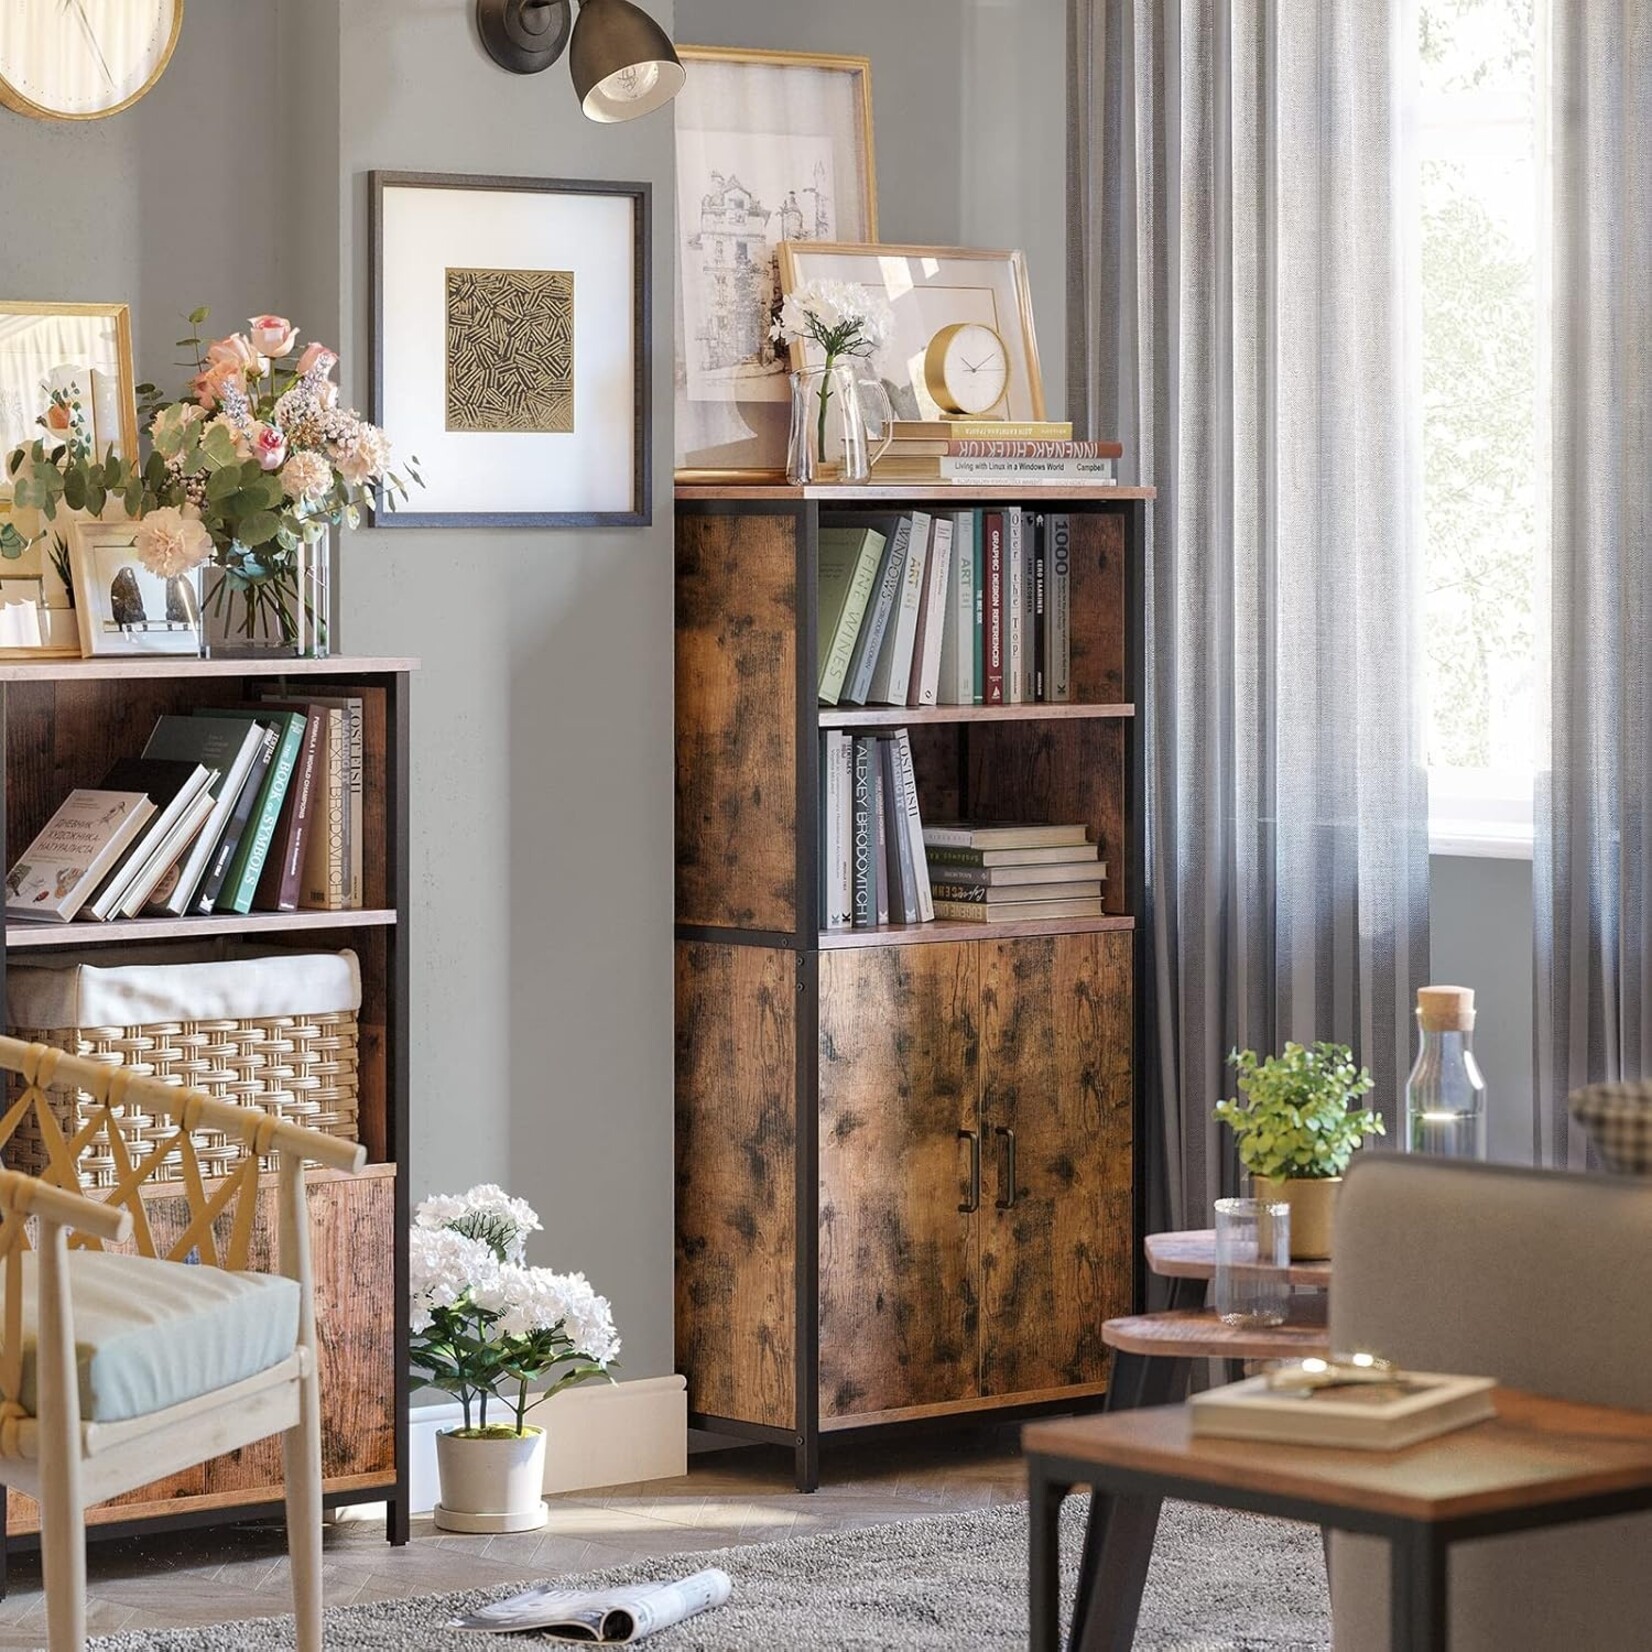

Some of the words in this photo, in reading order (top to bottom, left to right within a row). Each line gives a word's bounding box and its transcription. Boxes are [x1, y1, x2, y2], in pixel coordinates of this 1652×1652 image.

[955, 463, 974, 471] Living
[1046, 463, 1065, 471] World
[959, 441, 1098, 458] INNENARCHITEKTUR
[1076, 463, 1104, 472] Campbell
[881, 525, 912, 601] WINDOWS
[1055, 521, 1069, 576] 1000
[854, 552, 876, 600] FINE
[907, 556, 921, 589] ART
[961, 559, 972, 588] ART
[830, 610, 860, 679] WINES
[309, 716, 320, 749] FORMULA
[329, 715, 342, 783] ALEXEY
[350, 705, 361, 754] LOST
[270, 761, 291, 800] BOOK
[305, 754, 314, 779] WORLD
[350, 755, 361, 793] FISH
[856, 745, 868, 807] ALEXEY
[891, 748, 904, 794] MAKING
[898, 735, 912, 777] LOST
[905, 779, 918, 817] FISH
[298, 779, 312, 819] CHAMPIONS
[896, 794, 905, 809] IT
[244, 814, 274, 885] SYMBOLS
[329, 786, 342, 896] BRODOVITCH
[856, 812, 868, 915] BRODOVITCH
[950, 904, 983, 920] EUGENE
